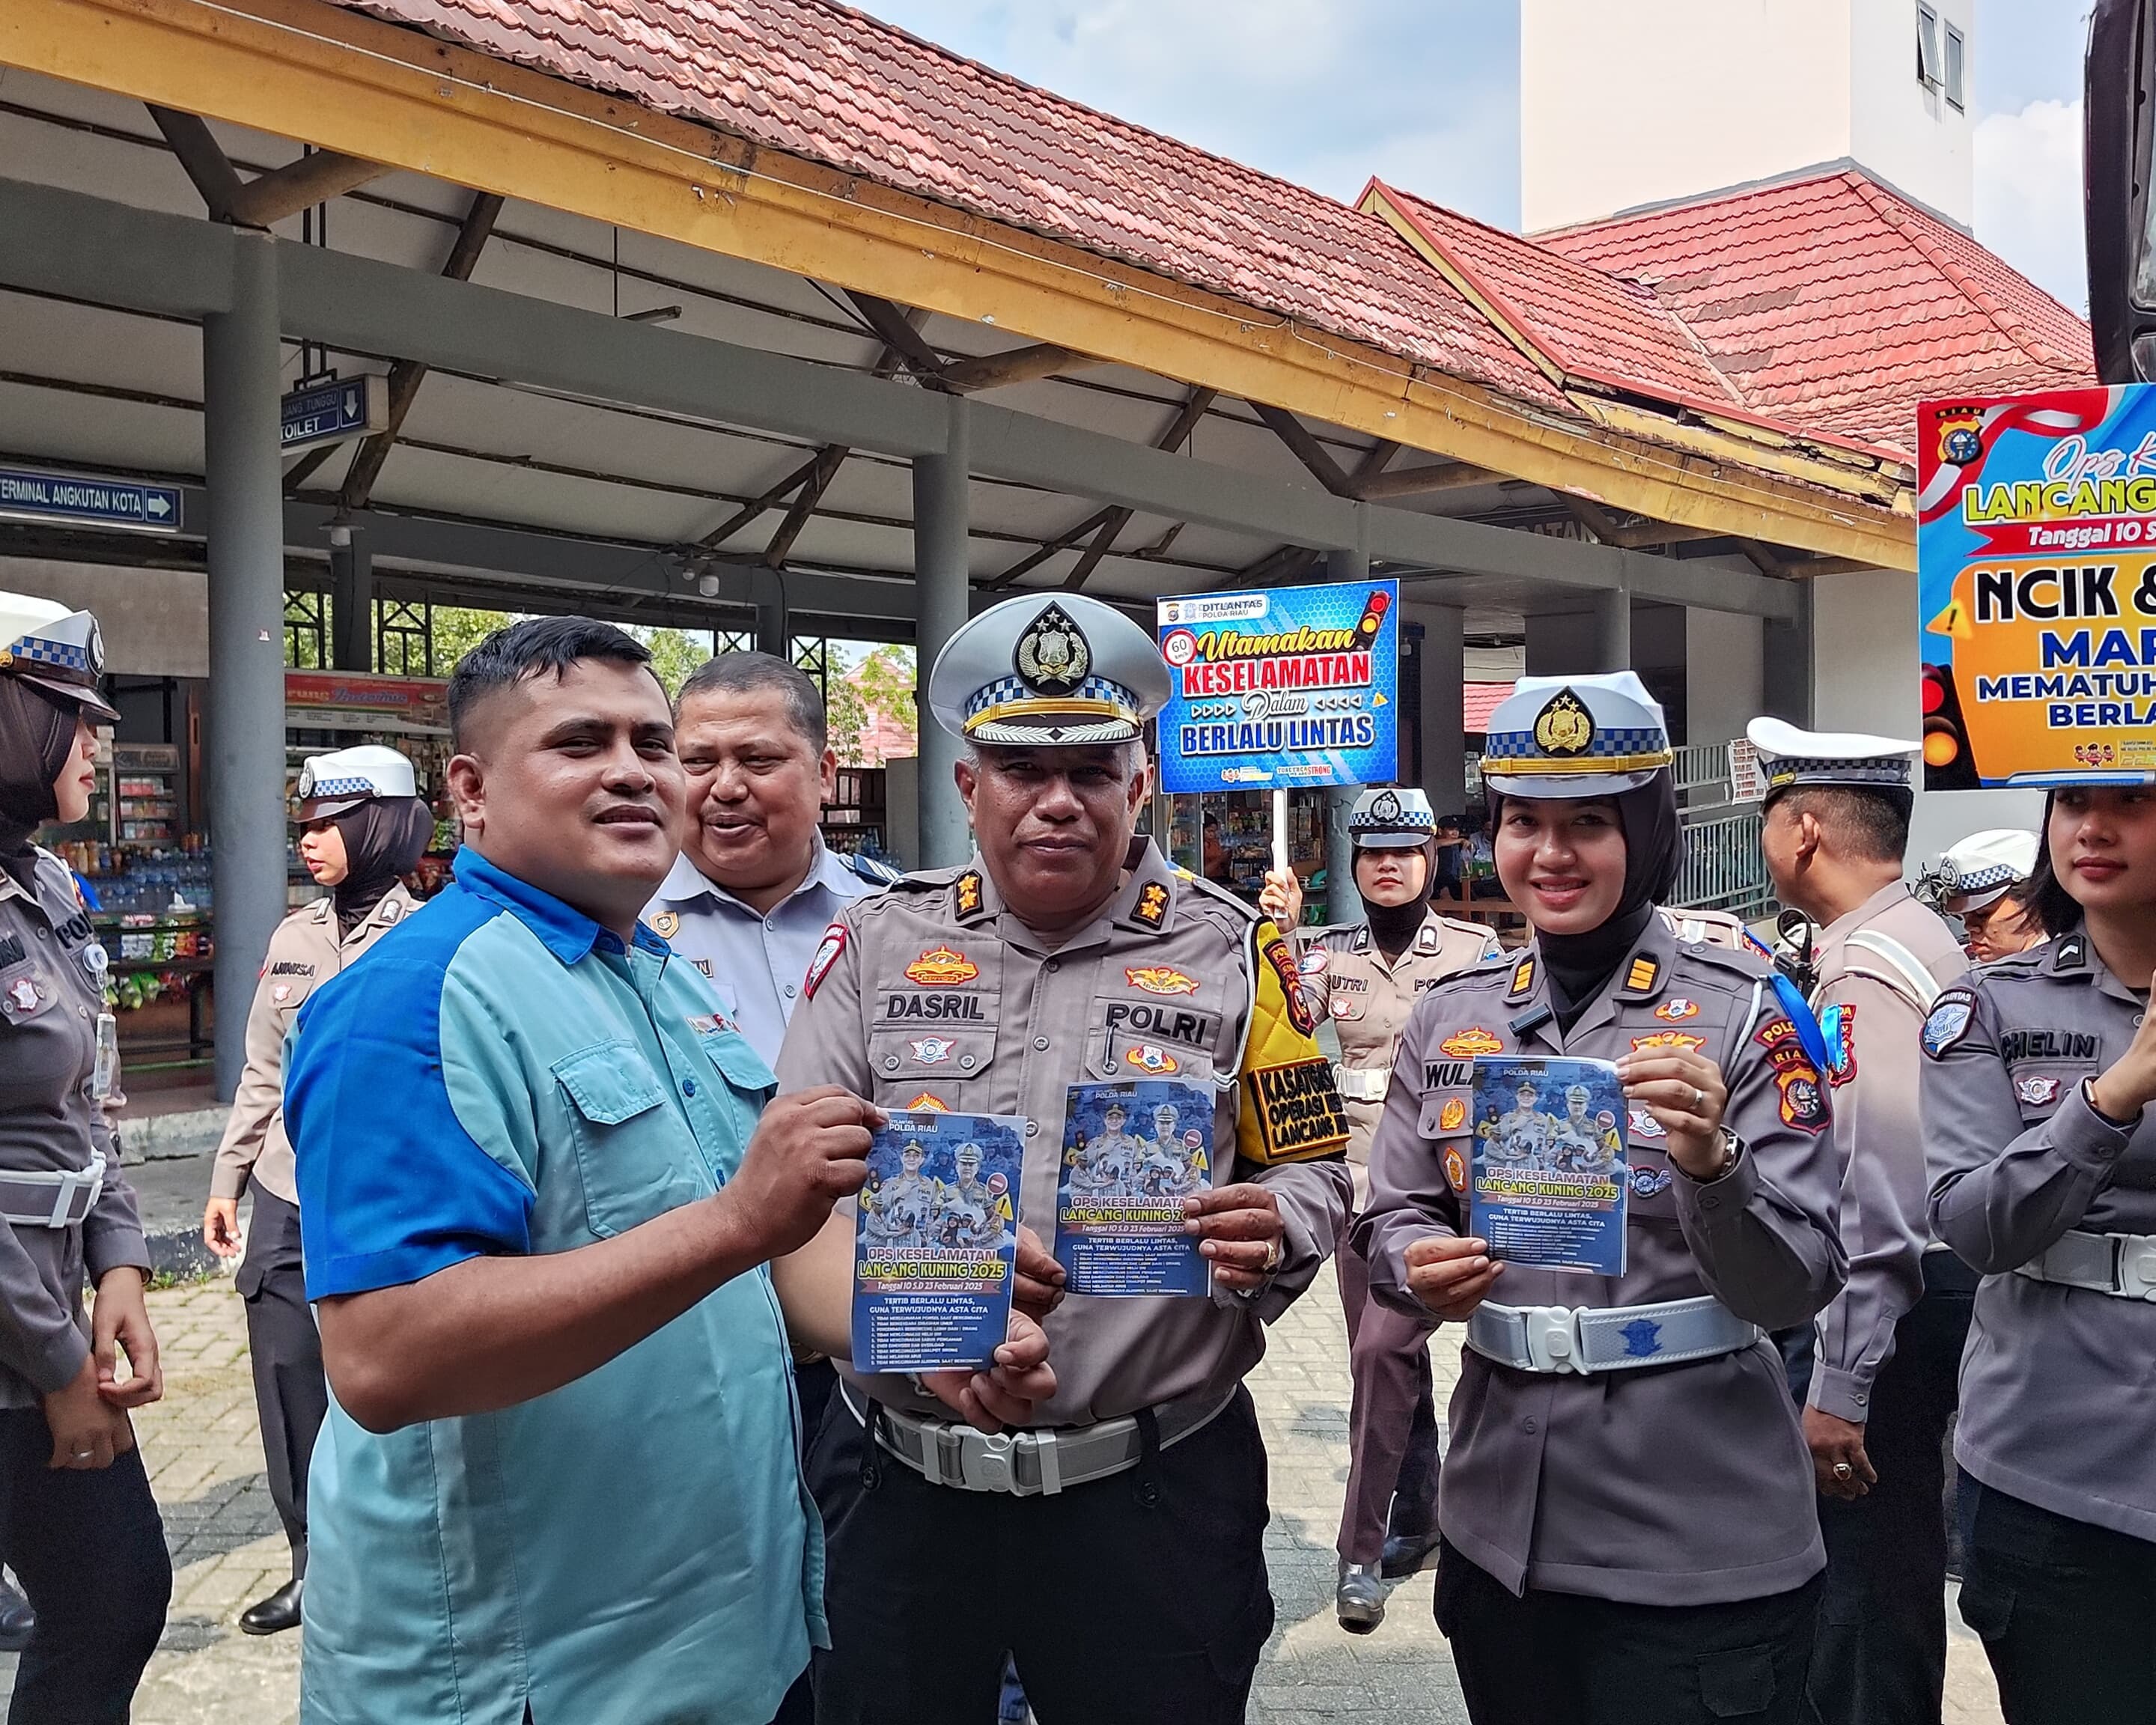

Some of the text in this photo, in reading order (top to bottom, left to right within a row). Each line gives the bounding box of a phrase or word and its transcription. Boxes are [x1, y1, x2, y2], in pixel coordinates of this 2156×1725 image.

[1939, 408, 1981, 417] RIAU
[2044, 434, 2126, 494] Ops
[0, 479, 142, 514] ERMINAL ANGKUTAN KOTA
[2029, 523, 2110, 548] Tanggal
[2116, 523, 2141, 541] 10
[1976, 567, 2119, 621] NCIK
[1202, 599, 1263, 612] DITLANTAS
[1202, 611, 1228, 619] POLDA
[1172, 639, 1187, 653] 60
[1197, 627, 1356, 662] Utamakan
[1184, 654, 1371, 695] KESELAMATAN
[1243, 690, 1308, 719] Dalam
[1182, 716, 1373, 753] BERLALU LINTAS
[1329, 977, 1368, 992] UTRI
[886, 994, 984, 1020] DASRIL
[1106, 1003, 1207, 1044] POLRI
[889, 1124, 938, 1133] POLDA RIAU
[1272, 1115, 1335, 1149] LANCANG
[1487, 1168, 1609, 1184] OPS KESELAMATAN
[1476, 1178, 1618, 1198] LANCANG KUNING 2025
[1073, 1197, 1187, 1208] OPS KESELAMATA
[1497, 1196, 1522, 1206] Tanggal
[1552, 1199, 1580, 1208] Februari
[1062, 1208, 1123, 1222] LANCANG
[1125, 1209, 1171, 1222] KUNING
[1503, 1208, 1528, 1216] TERTIB
[1511, 1216, 1566, 1225] TERWUJUDNYA
[1082, 1225, 1108, 1233] Tanggal
[1139, 1225, 1167, 1233] Februari
[868, 1249, 996, 1262] OPS KESELAMATAN
[859, 1262, 1005, 1279] LANCANG KUNING 2025
[877, 1281, 903, 1292] Tanggal
[913, 1282, 924, 1290] S.D
[925, 1282, 934, 1290] 23
[934, 1282, 963, 1290] Februari
